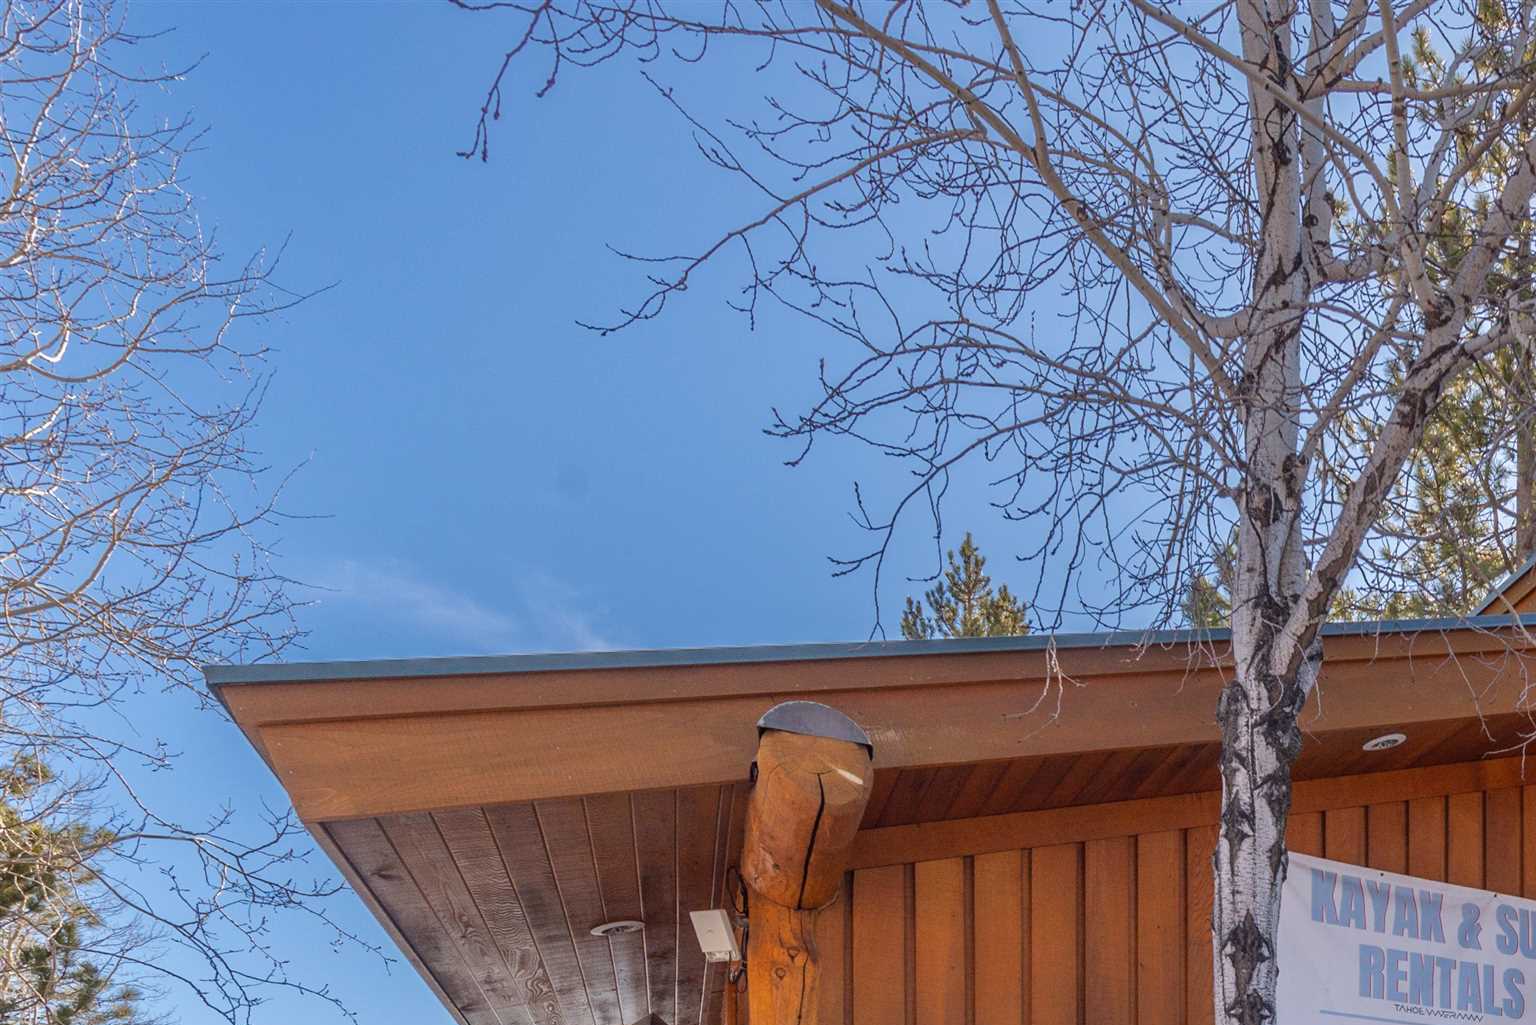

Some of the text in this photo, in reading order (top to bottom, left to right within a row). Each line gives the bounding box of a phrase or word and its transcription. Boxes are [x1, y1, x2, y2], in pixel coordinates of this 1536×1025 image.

[1311, 868, 1446, 944] KAYAK
[1458, 903, 1482, 950] &
[1359, 944, 1525, 1019] RENTALS
